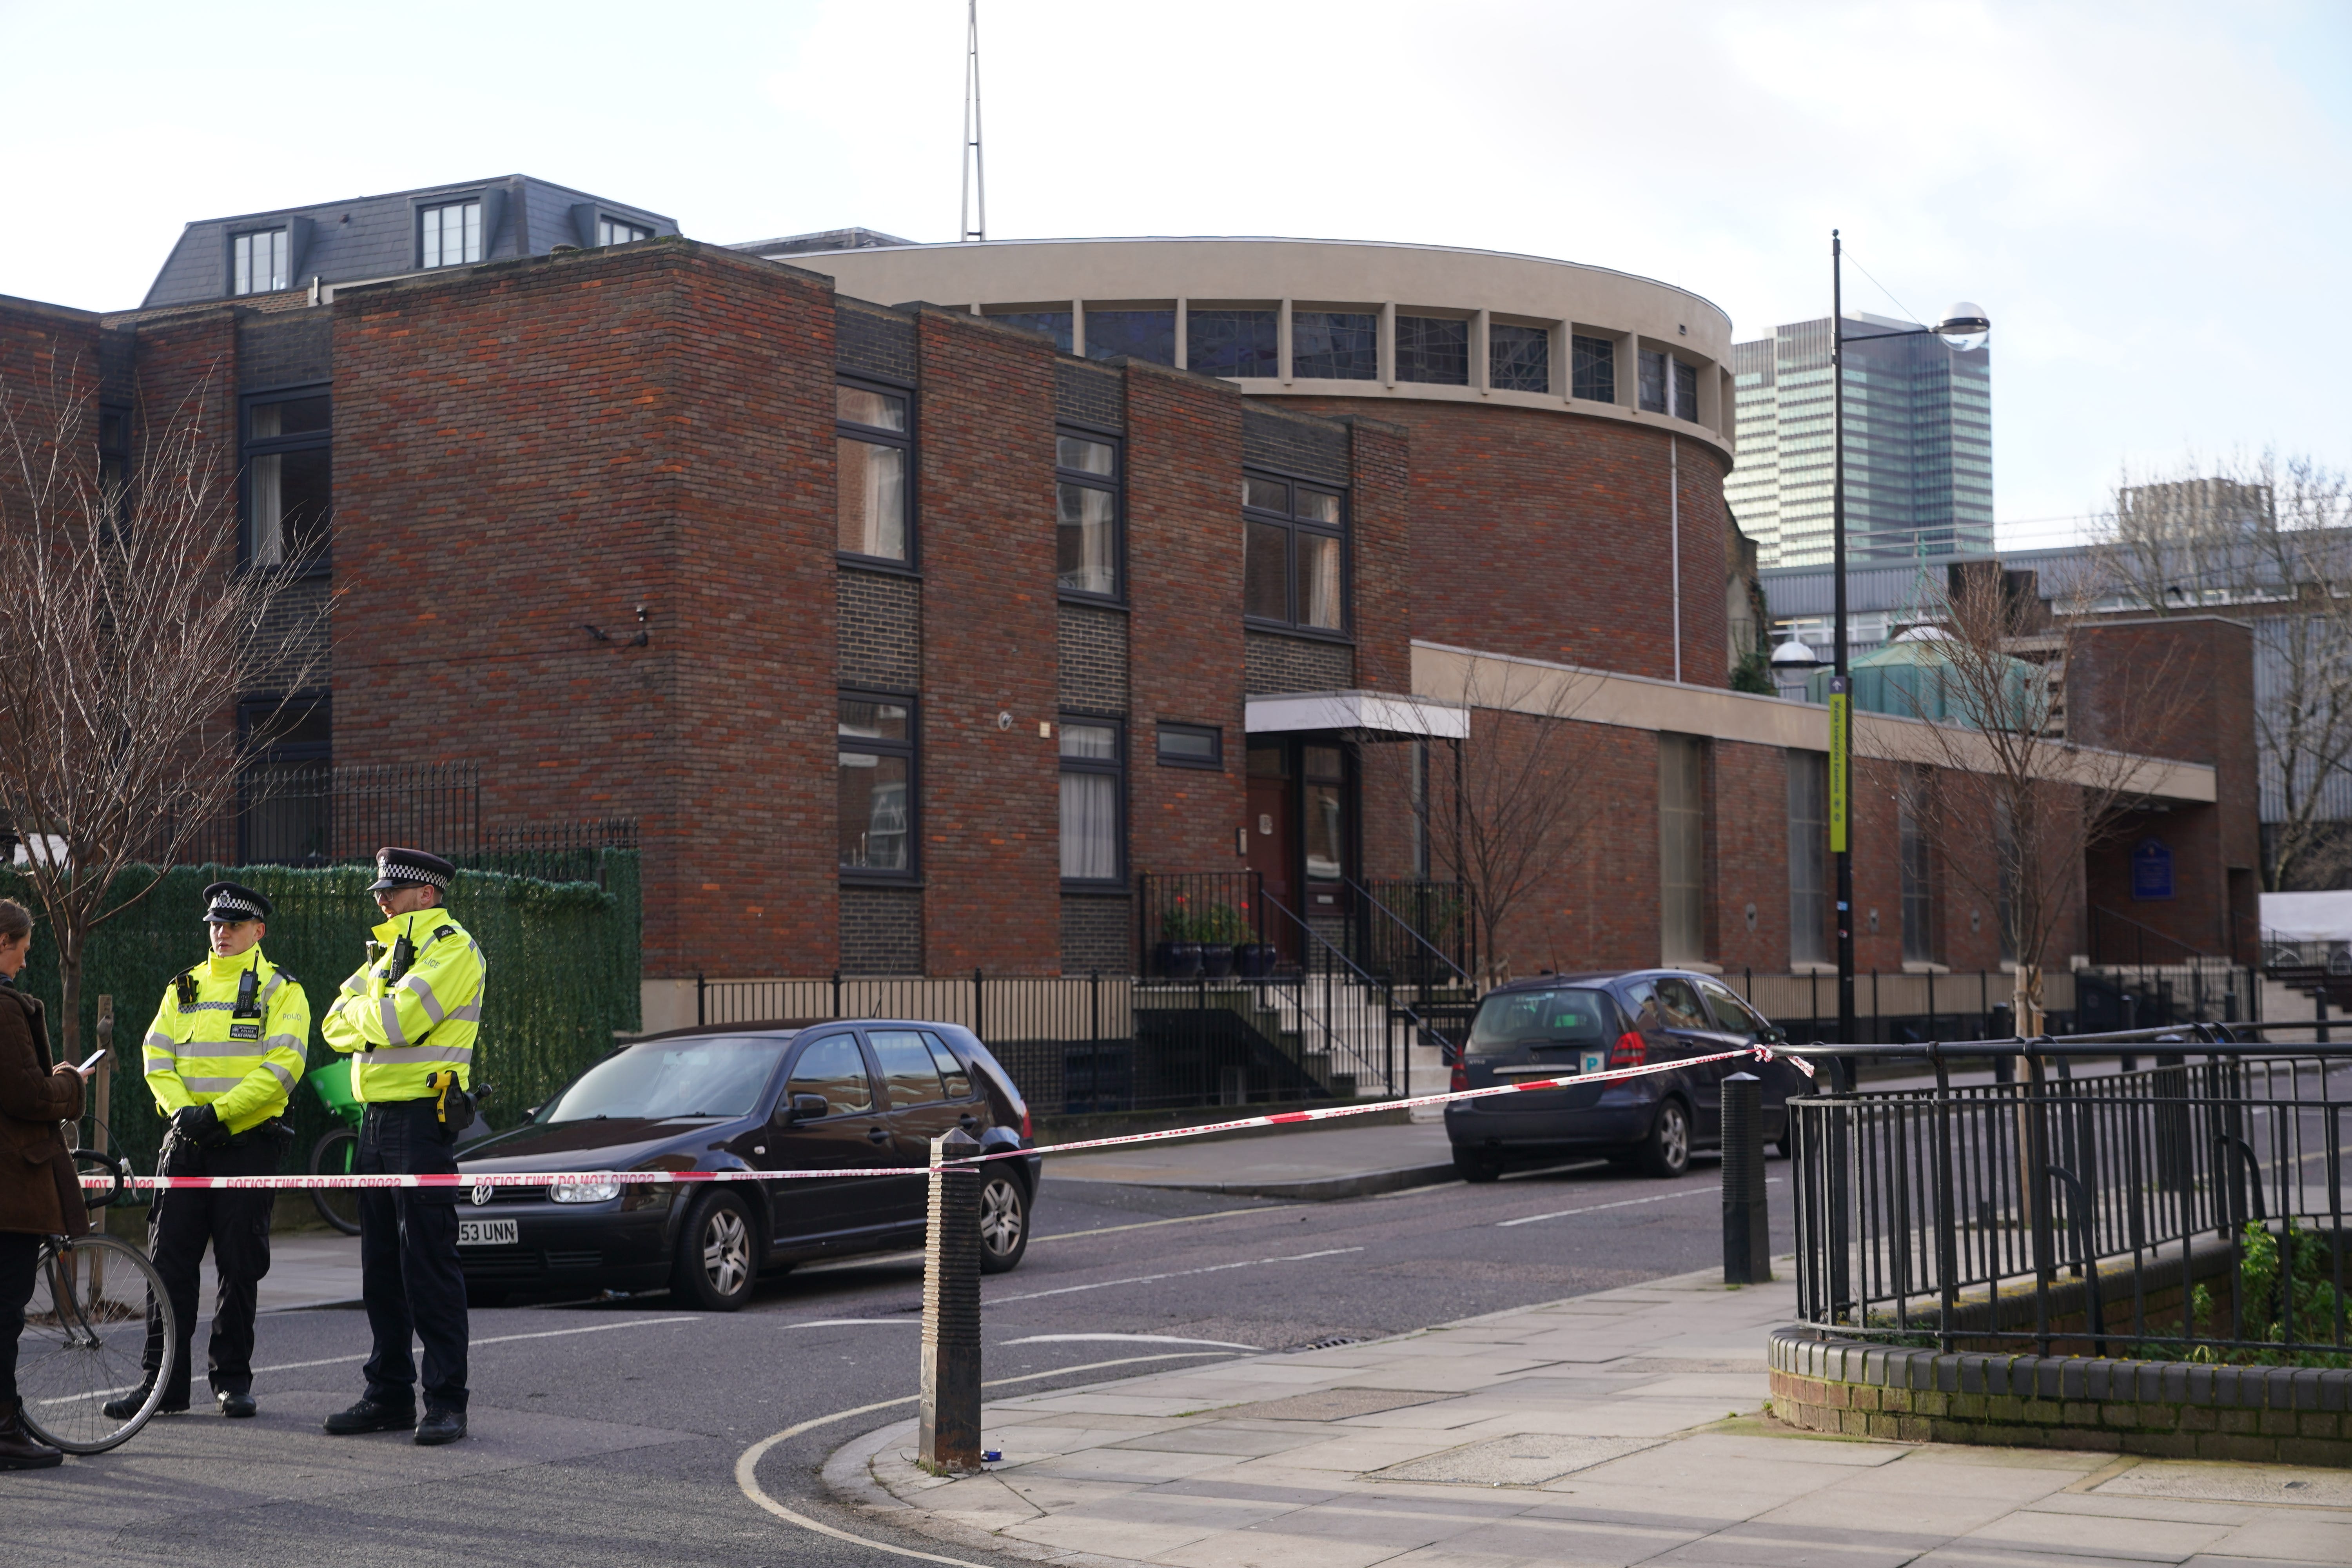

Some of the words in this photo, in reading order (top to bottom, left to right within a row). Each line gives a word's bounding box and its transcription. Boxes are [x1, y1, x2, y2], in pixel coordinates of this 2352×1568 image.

[422, 957, 440, 969] LICE
[1586, 1057, 1598, 1071] P
[458, 1224, 479, 1240] 53
[483, 1223, 515, 1241] UNN
